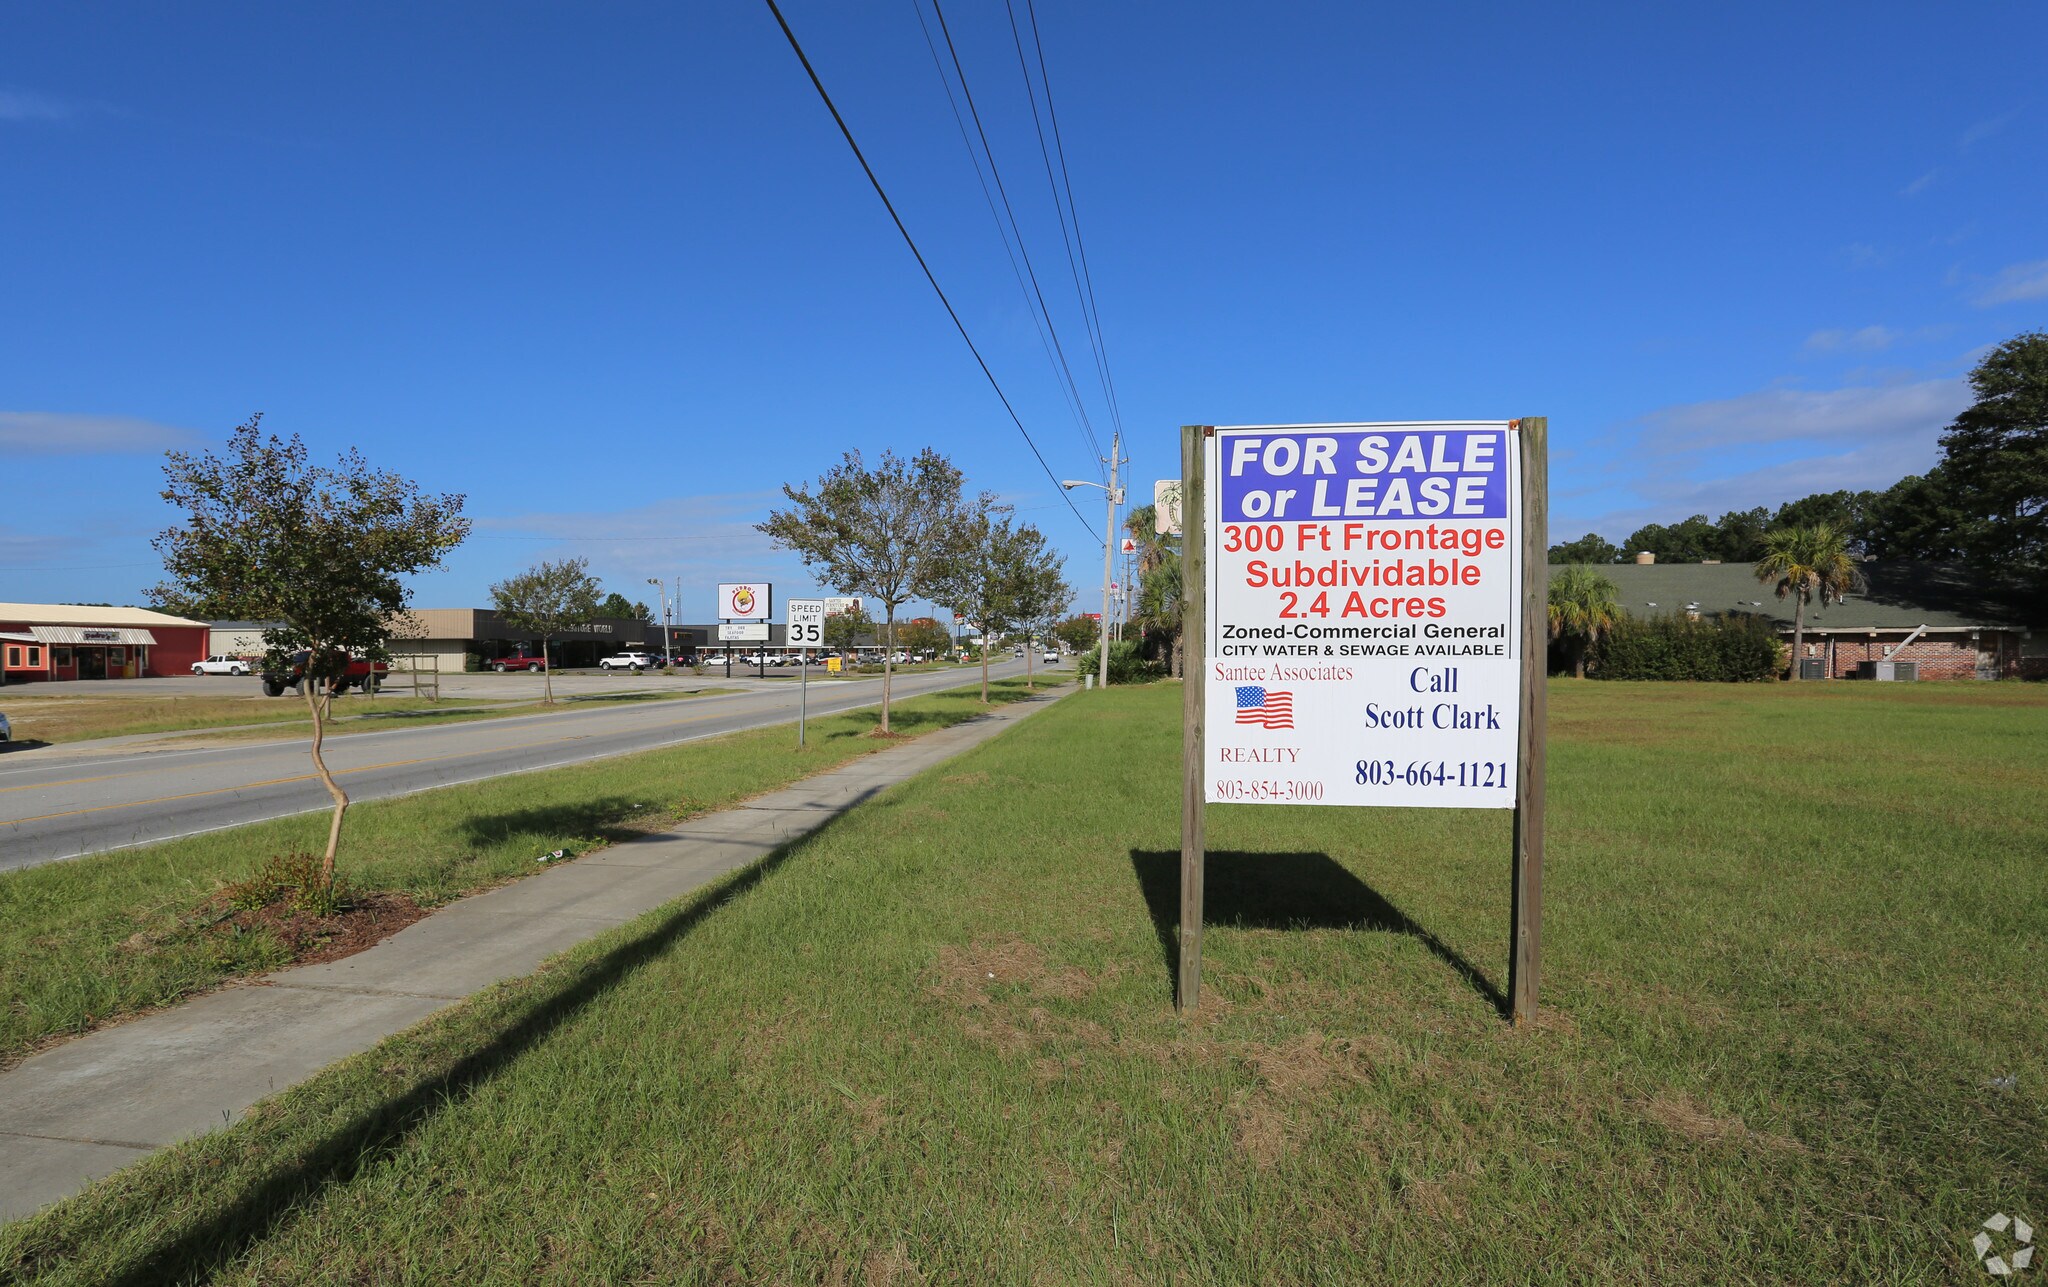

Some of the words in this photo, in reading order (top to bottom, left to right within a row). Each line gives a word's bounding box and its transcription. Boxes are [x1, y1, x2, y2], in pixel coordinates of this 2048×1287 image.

[1230, 437, 1338, 476] FOR
[1356, 435, 1497, 474] SALE
[1242, 490, 1296, 518] or
[1312, 477, 1487, 516] LEASE
[1224, 525, 1283, 552] 300
[1298, 524, 1331, 551] Ft
[1344, 524, 1504, 556] Frontage
[1246, 559, 1480, 587] Subdividable
[791, 604, 821, 613] SPEED
[1279, 591, 1330, 618] 2.4
[1341, 591, 1446, 618] Acres
[791, 624, 820, 642] 35
[1223, 624, 1415, 638] Zoned-Commercial
[1424, 624, 1504, 638] General
[1223, 645, 1258, 656] CITY
[1263, 645, 1317, 655] WATER
[1324, 645, 1333, 655] &
[1340, 645, 1409, 655] SEWAGE
[1415, 645, 1503, 655] AVAILABLE
[1216, 663, 1265, 681] Santee
[1270, 662, 1352, 680] Associates
[1410, 667, 1458, 693] Call
[1366, 703, 1424, 729] Scott
[1433, 704, 1500, 729] Clark
[1221, 748, 1299, 762] REALTY
[1356, 760, 1507, 788] 803-664-1121
[1216, 780, 1323, 800] 803-854-3000
